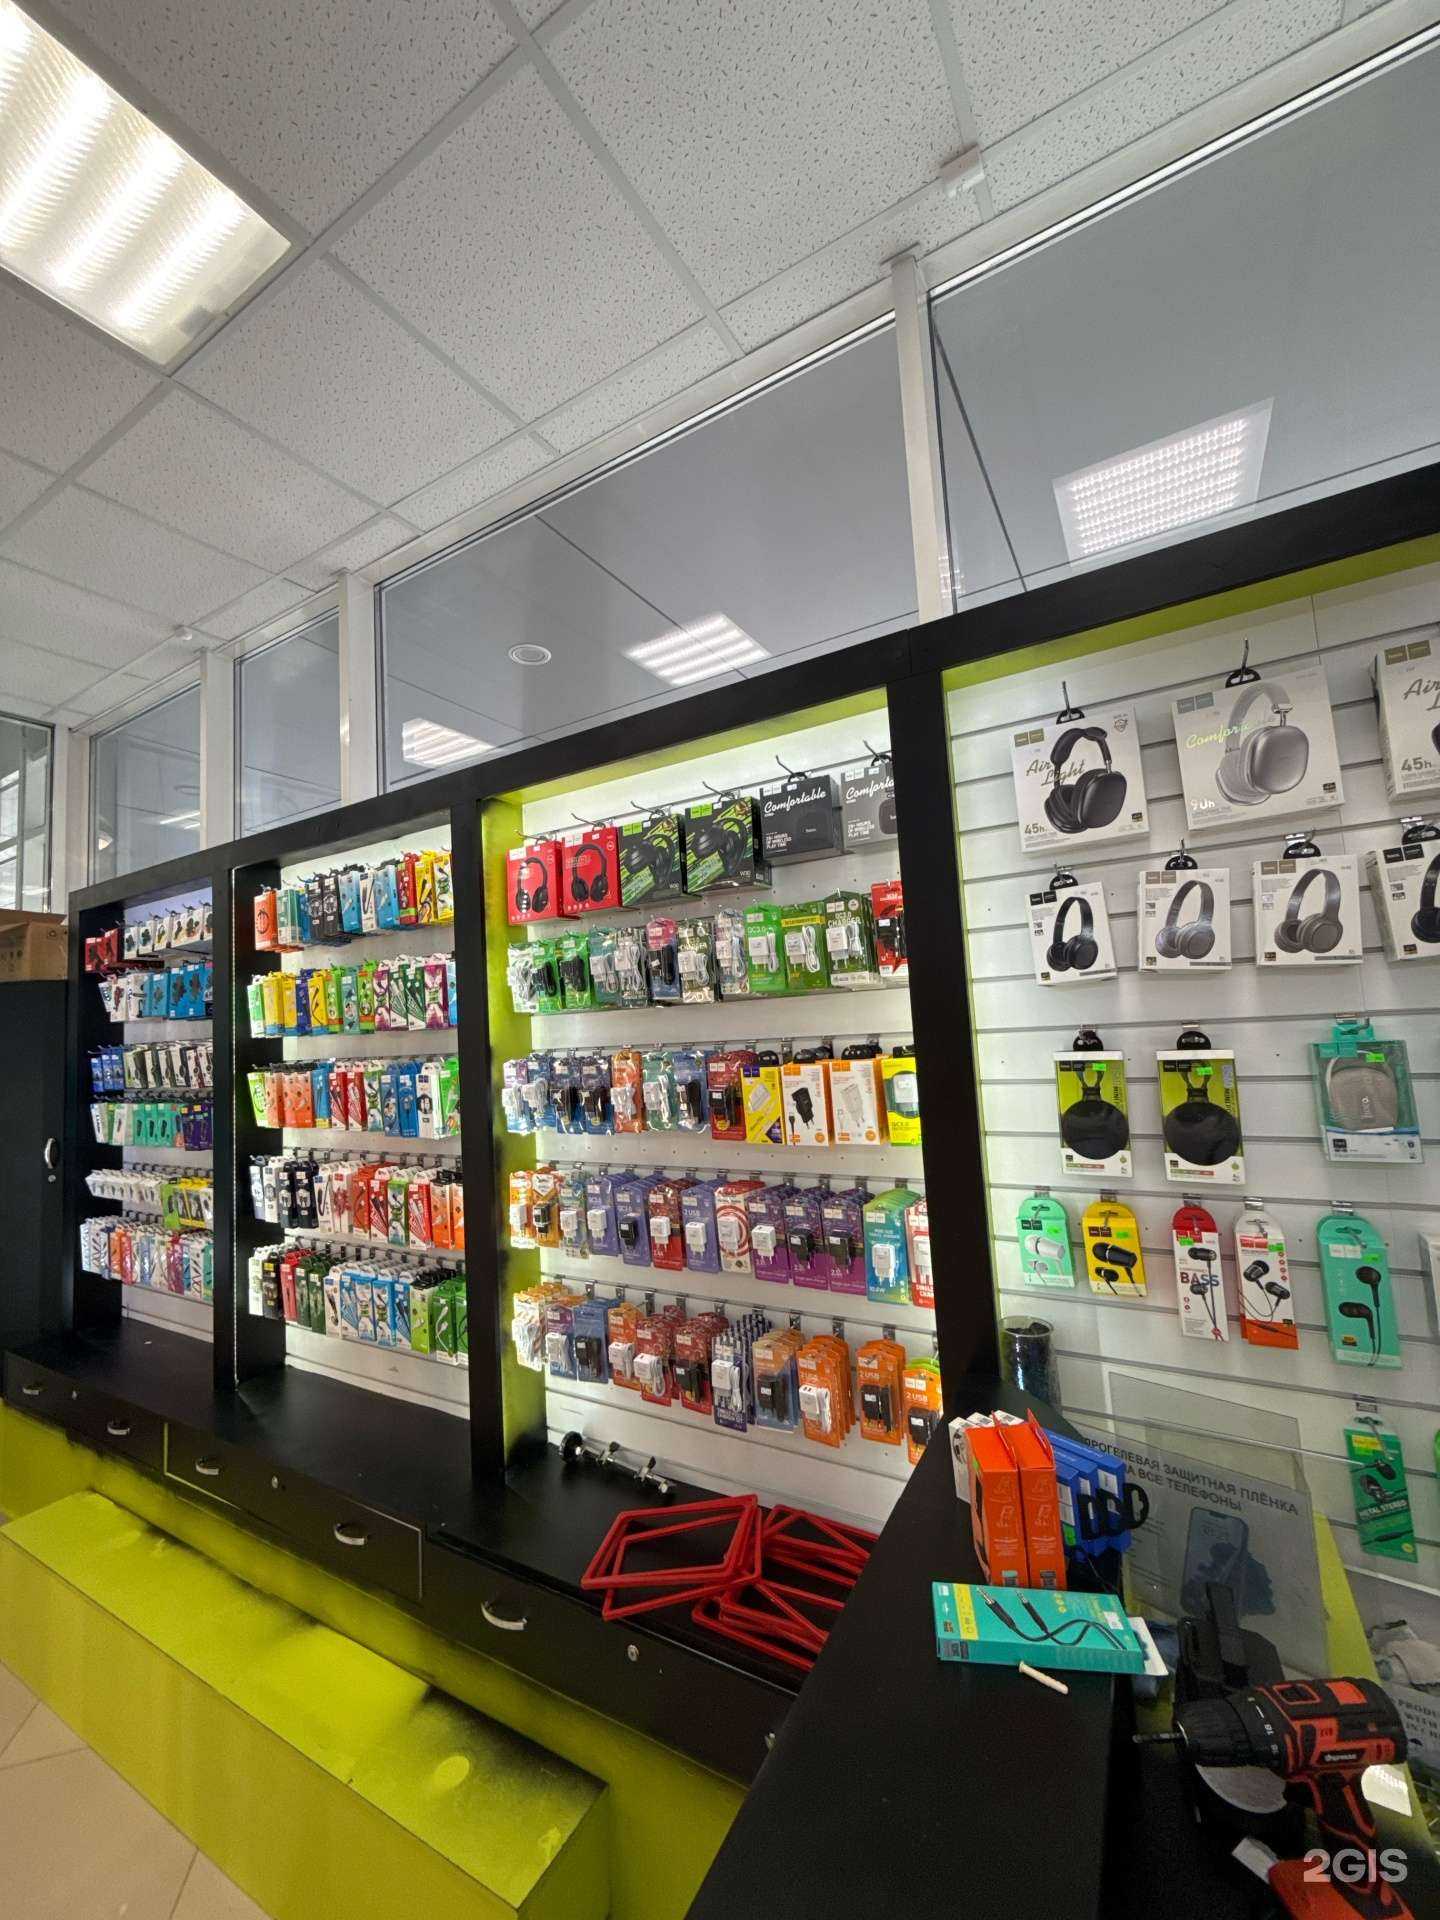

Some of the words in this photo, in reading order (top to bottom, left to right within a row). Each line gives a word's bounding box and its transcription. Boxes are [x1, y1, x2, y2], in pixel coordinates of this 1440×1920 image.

[1026, 759, 1052, 777] Air
[763, 787, 827, 812] Comfortable
[845, 776, 895, 800] Comforta
[1180, 1272, 1219, 1287] BASS
[912, 1393, 928, 1403] USB
[1085, 1437, 1160, 1471] РОГЕЛЕВАЯ
[1163, 1463, 1236, 1495] ЗАЩИТНАЯ
[1240, 1487, 1299, 1516] ПЛЁНКА
[1138, 1468, 1164, 1485] ВСЕ
[1166, 1477, 1242, 1511] ТЕЛЕФОНЫ
